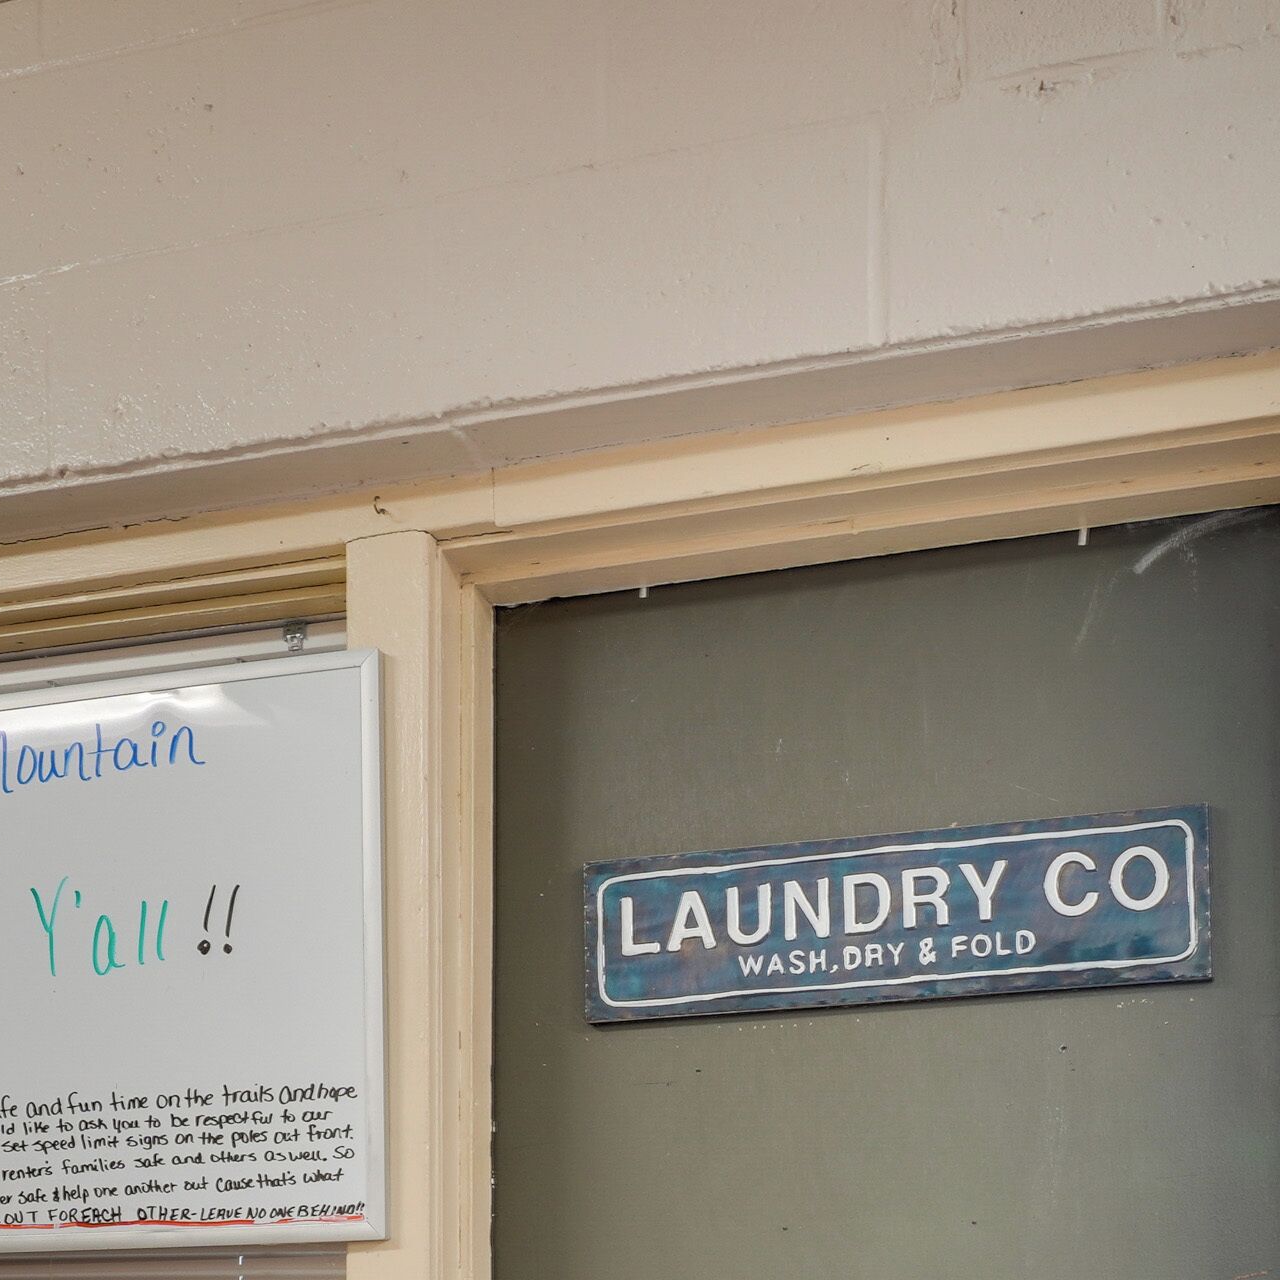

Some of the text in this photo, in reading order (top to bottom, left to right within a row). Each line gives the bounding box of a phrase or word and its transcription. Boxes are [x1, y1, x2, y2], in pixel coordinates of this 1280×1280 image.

[619, 844, 1170, 957] LAUNDRY CO
[917, 936, 937, 967] &
[951, 929, 1037, 959] FOLD
[26, 1098, 63, 1118] and
[67, 1091, 103, 1114] fun
[109, 1091, 149, 1111] time
[156, 1094, 181, 1109] on
[184, 1088, 214, 1107] the
[222, 1083, 274, 1106] trails
[23, 1121, 50, 1135] like
[56, 1118, 73, 1132] to
[78, 1118, 108, 1131] ask
[113, 1118, 140, 1133] you
[144, 1115, 161, 1129] to
[170, 1113, 190, 1127] be
[280, 1109, 296, 1123] to
[301, 1110, 333, 1122] our
[1, 1140, 29, 1153] set
[33, 1136, 76, 1154] speed
[81, 1134, 119, 1149] limit
[126, 1133, 169, 1150] signs
[175, 1133, 194, 1145] on
[198, 1131, 224, 1145] the
[231, 1129, 268, 1148] poles
[274, 1129, 301, 1144] out
[306, 1124, 354, 1142] front.
[62, 1158, 126, 1175] families
[134, 1152, 166, 1168] safe
[172, 1152, 205, 1165] and
[210, 1150, 257, 1163] others
[332, 1146, 355, 1160] So
[18, 1188, 48, 1205] safe
[63, 1184, 89, 1203] help
[94, 1184, 118, 1198] one
[124, 1179, 178, 1196] another
[184, 1176, 208, 1191] out
[255, 1170, 297, 1188] that's
[303, 1167, 344, 1183] what
[4, 1210, 38, 1225] OUT
[47, 1208, 78, 1222] FOR
[81, 1206, 122, 1223] EACH
[246, 1207, 266, 1219] NO
[270, 1206, 295, 1218] ONE
